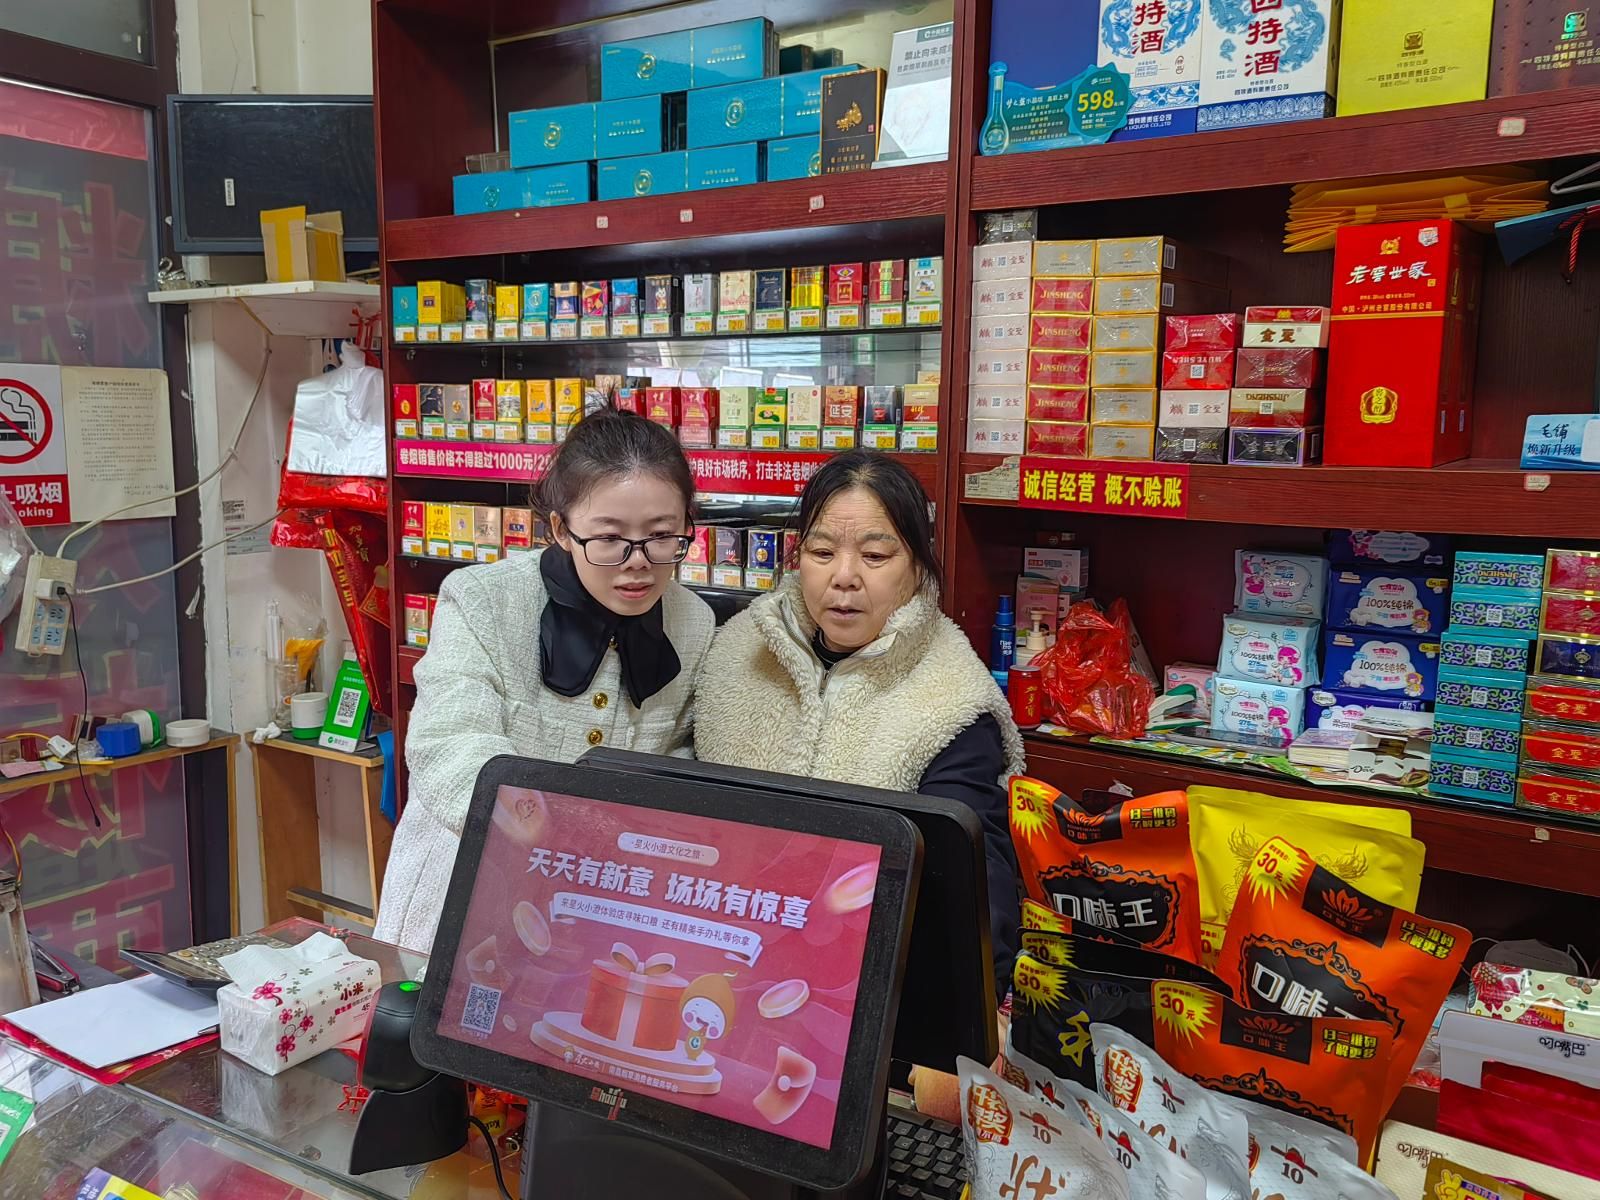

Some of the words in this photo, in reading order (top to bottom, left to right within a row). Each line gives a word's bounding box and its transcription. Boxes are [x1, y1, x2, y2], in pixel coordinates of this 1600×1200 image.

[1077, 89, 1115, 112] 598
[1023, 470, 1095, 503] 诚信经营
[1105, 474, 1182, 508] 概不赊账
[18, 507, 54, 518] oking
[527, 847, 653, 897] 天天有新意
[665, 873, 811, 929] 场场有惊喜
[1053, 893, 1158, 928] 口味王
[340, 982, 364, 1001] 小米
[1252, 962, 1361, 1017] 口味
[1032, 1125, 1052, 1145] 10
[1115, 1147, 1132, 1170] 10
[1280, 1162, 1304, 1185] 10
